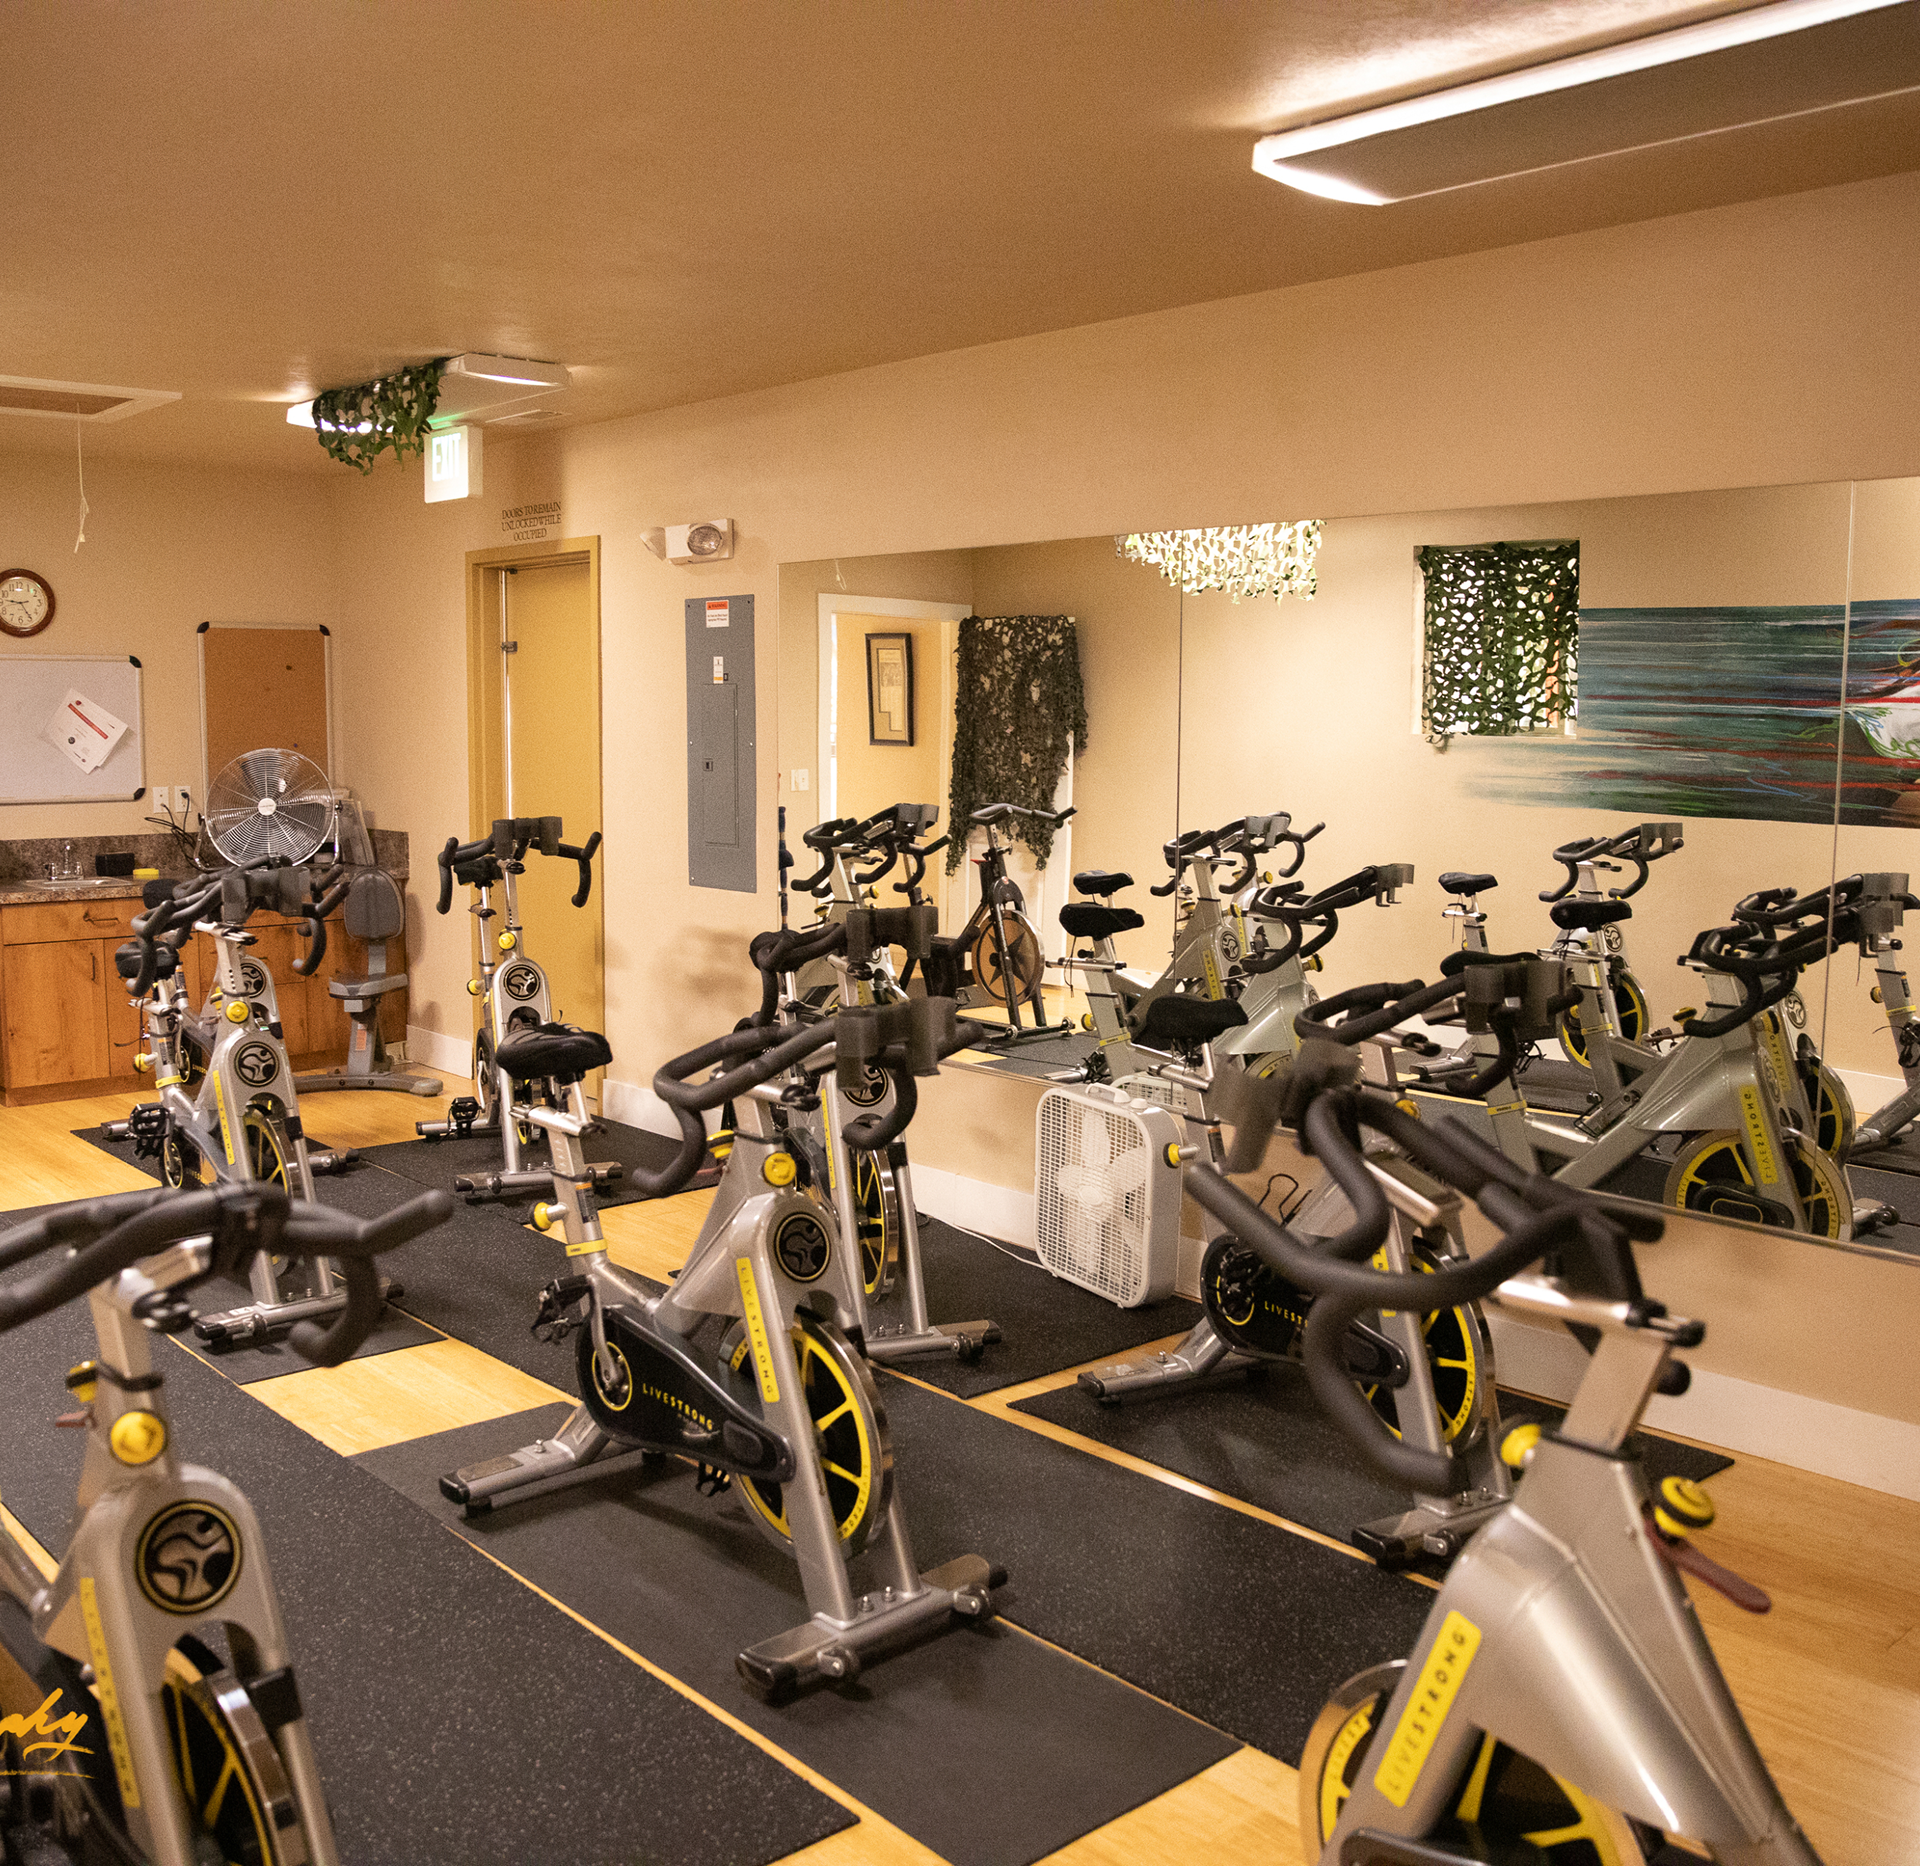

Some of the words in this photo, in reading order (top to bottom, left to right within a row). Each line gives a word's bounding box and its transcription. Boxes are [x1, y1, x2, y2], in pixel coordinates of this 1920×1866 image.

[432, 433, 461, 482] EXIT
[501, 507, 524, 519] DOORS
[533, 501, 562, 514] REMAIN
[501, 516, 539, 531] UNLOCKED
[538, 513, 562, 526] WHILE
[513, 528, 548, 541] OCCUPIED
[9, 583, 15, 592] 11
[16, 581, 23, 589] 12
[1, 590, 9, 598] 10
[33, 589, 38, 597] 2
[37, 599, 42, 607] 3
[2, 607, 7, 615] 8
[9, 613, 14, 621] 7
[18, 616, 24, 624] 6
[27, 613, 33, 622] 5
[740, 1265, 775, 1394] LIVESTRONG
[642, 1382, 713, 1431] LIVESTRONG
[1387, 1629, 1466, 1792] LIVESTRONG
